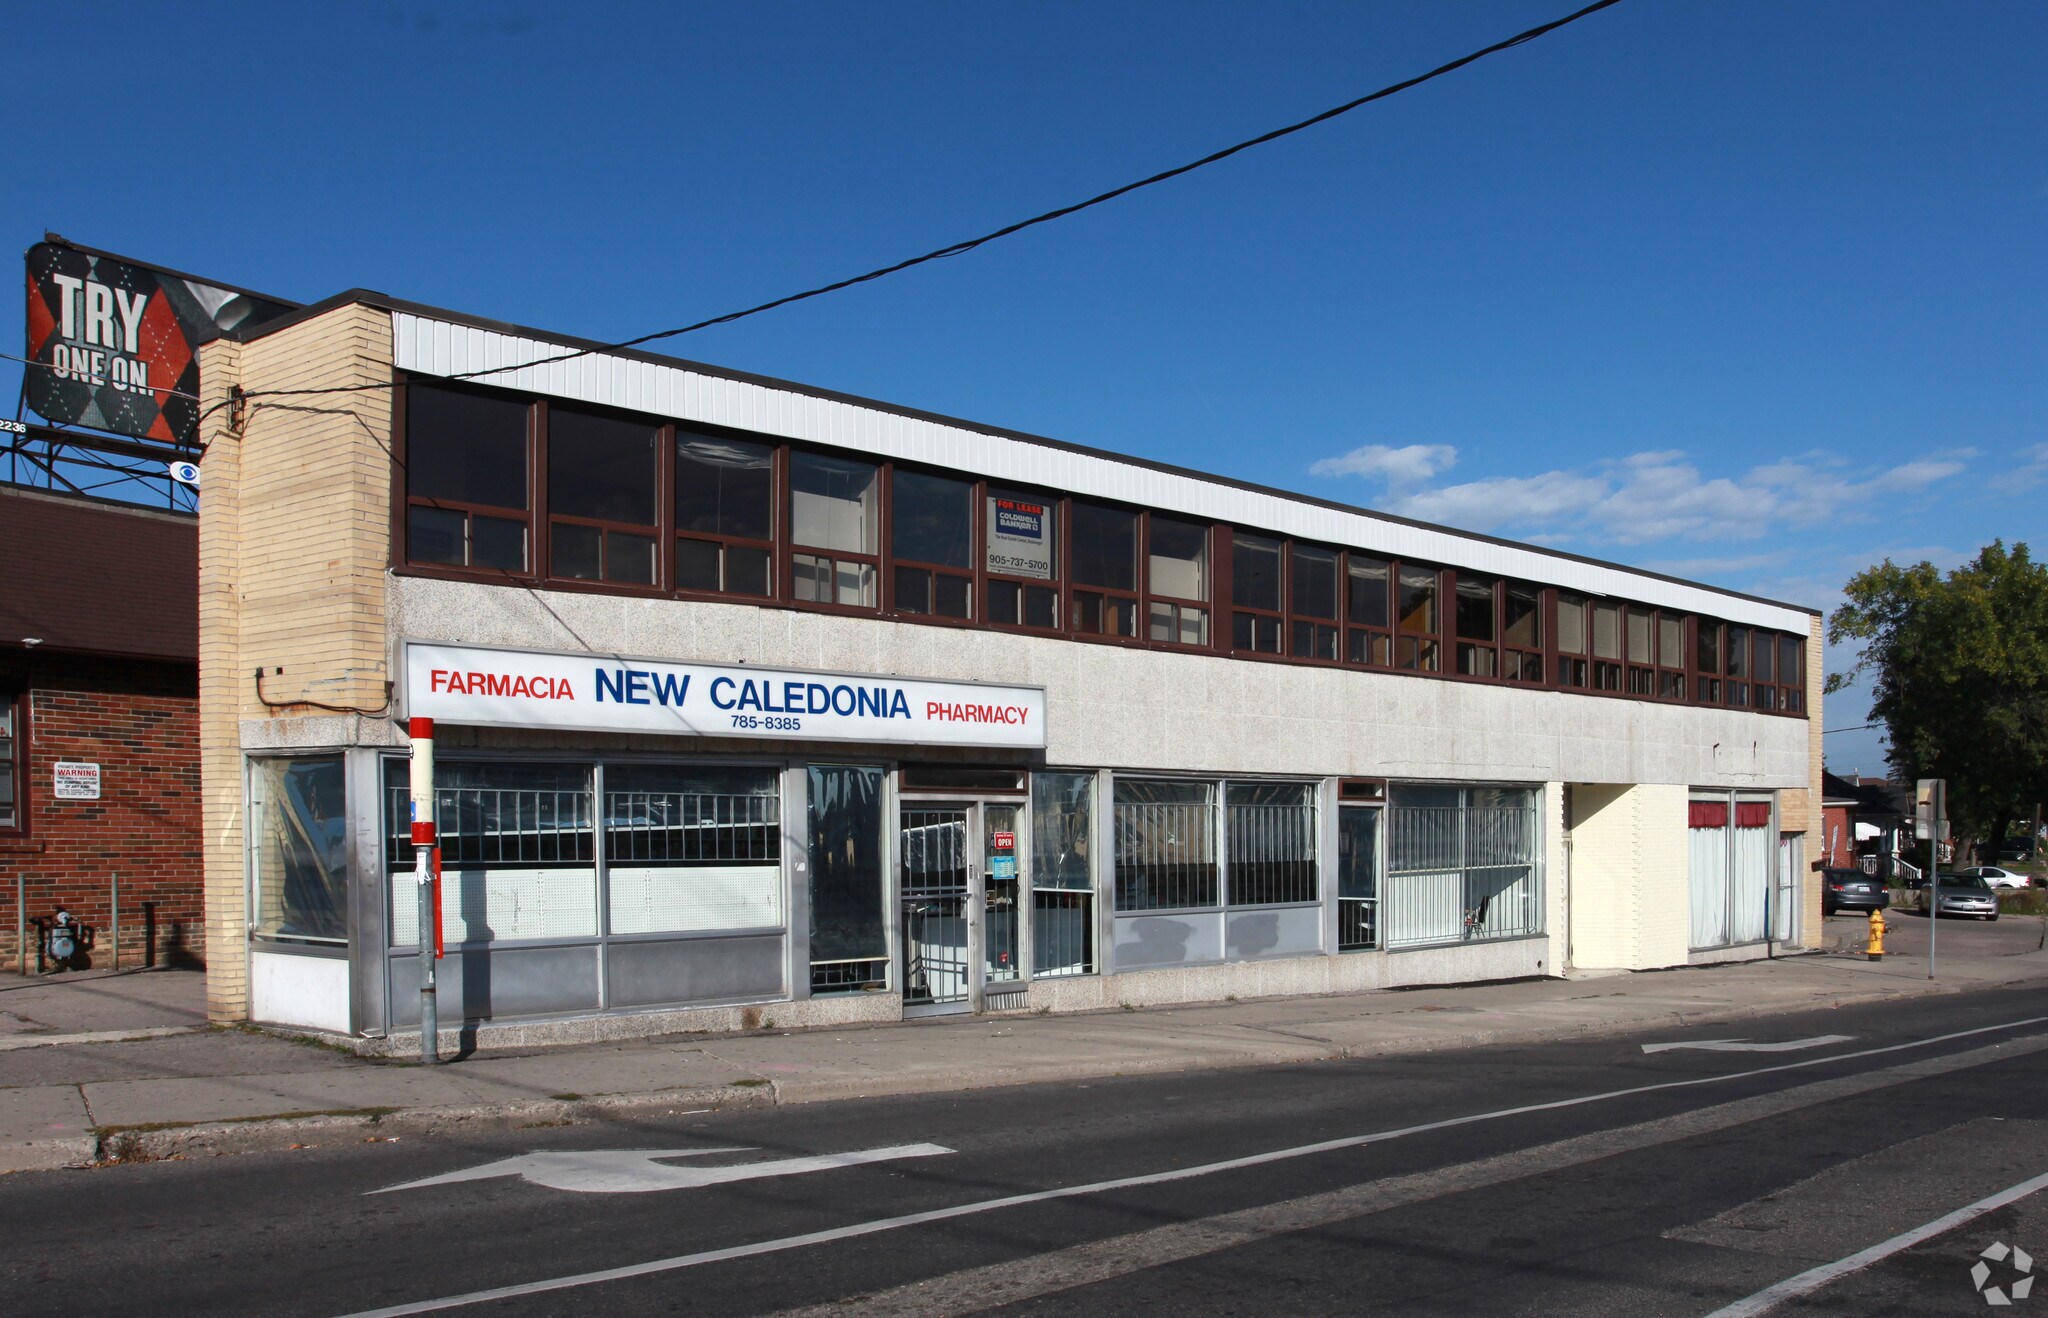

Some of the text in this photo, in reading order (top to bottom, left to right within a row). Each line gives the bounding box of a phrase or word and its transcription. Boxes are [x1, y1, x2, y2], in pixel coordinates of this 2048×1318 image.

[53, 272, 148, 355] TRY
[53, 343, 155, 397] ONE ON.
[998, 500, 1042, 514] FOR LEASE
[1000, 512, 1038, 524] COLDWELL
[1000, 519, 1032, 530] BANKER
[989, 554, 1048, 570] 905-737-5700
[430, 667, 1029, 725] FARMACIA NEW CALEDONIA PHARMACY
[730, 714, 801, 731] 785-8385
